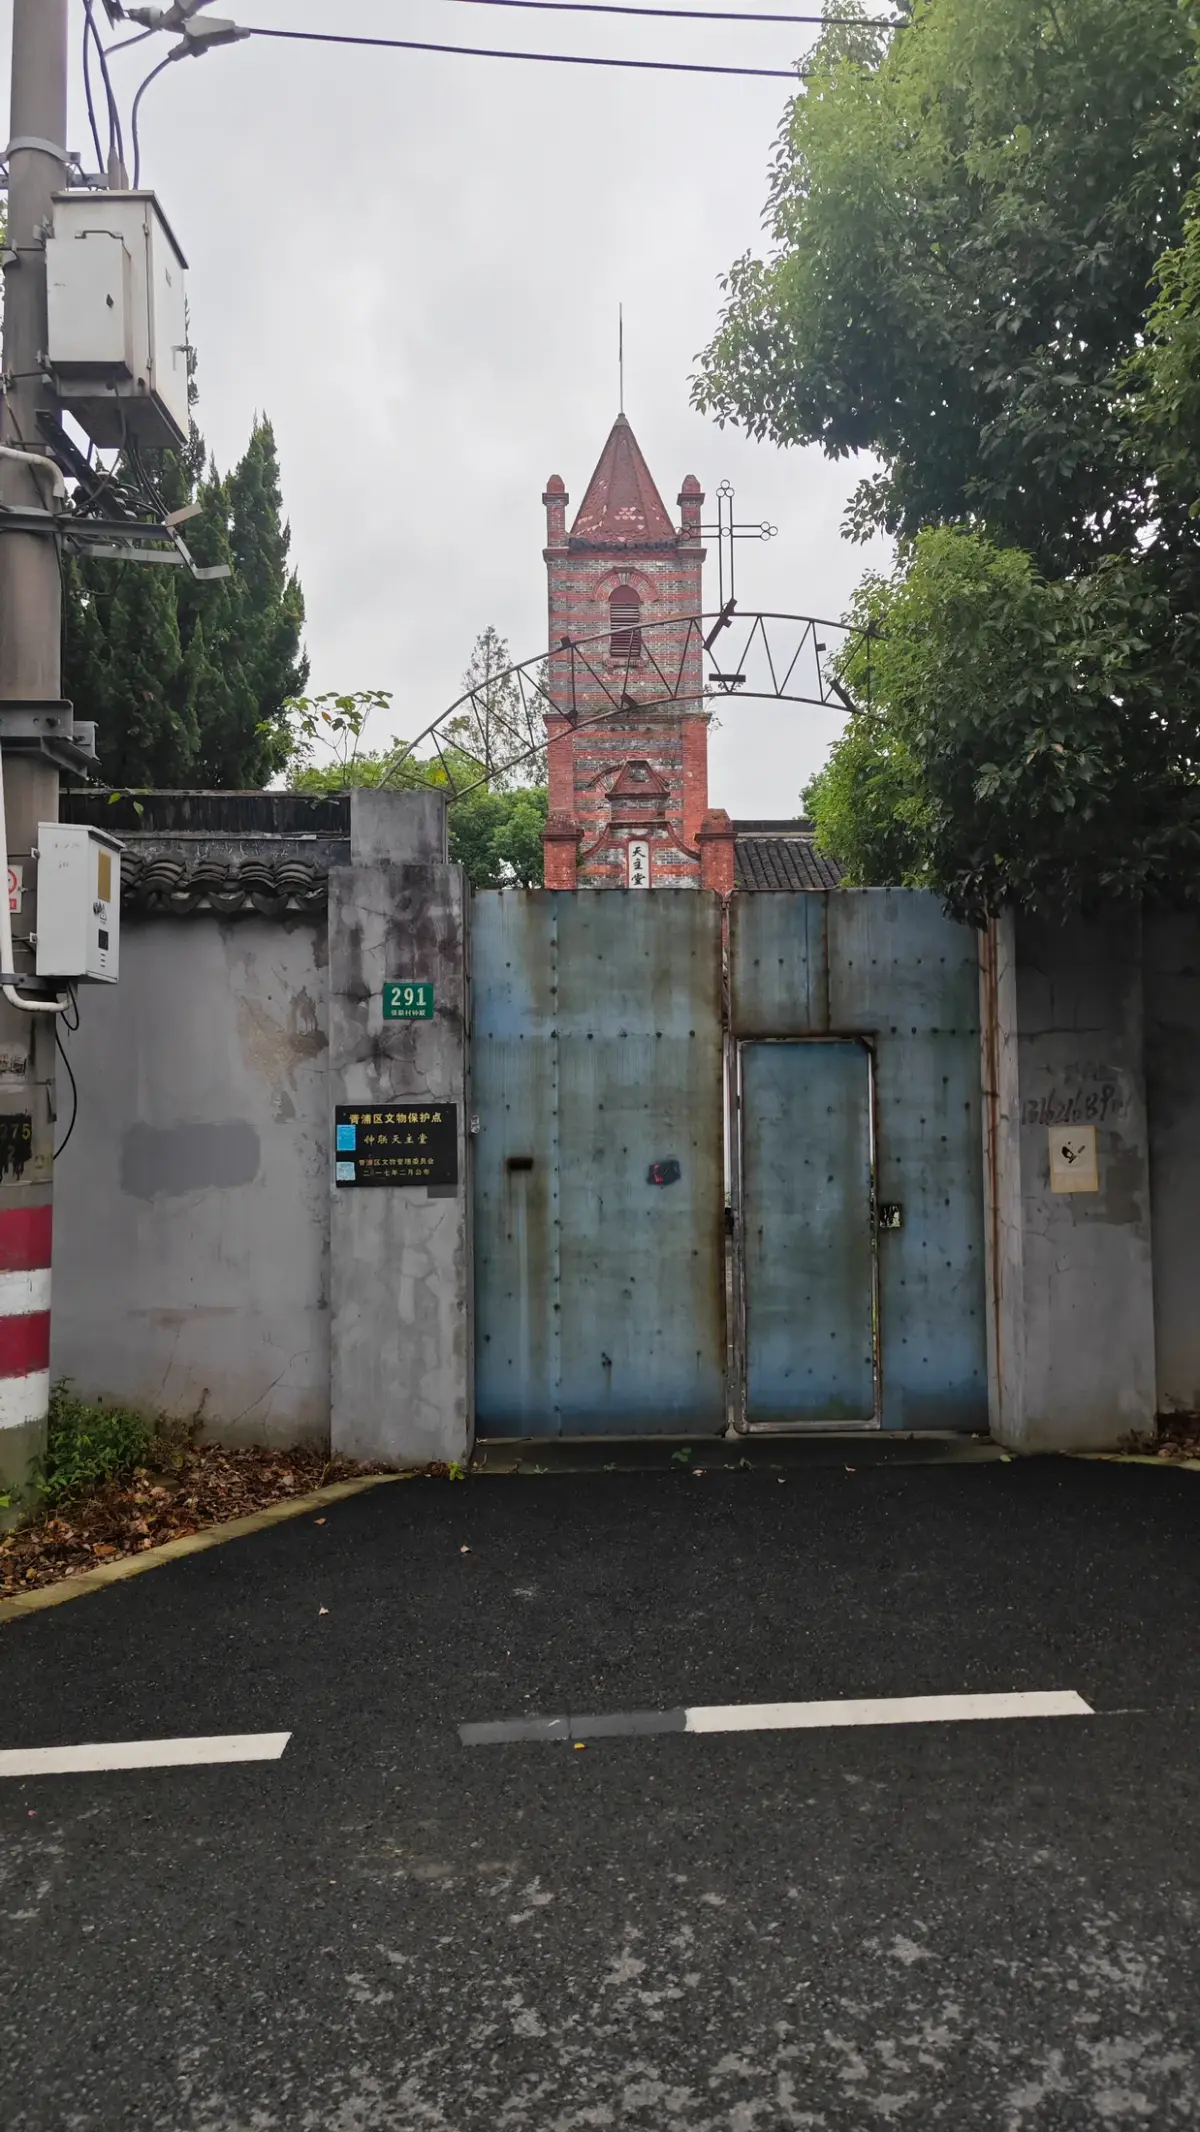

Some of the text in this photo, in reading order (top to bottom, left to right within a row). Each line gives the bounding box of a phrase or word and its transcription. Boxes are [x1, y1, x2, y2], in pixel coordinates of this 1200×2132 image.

[631, 846, 646, 886] 天主堂
[391, 987, 427, 1006] 291
[349, 1112, 442, 1125] 青浦区文物保护点
[358, 1157, 434, 1166] 青浦区文物管理委员会
